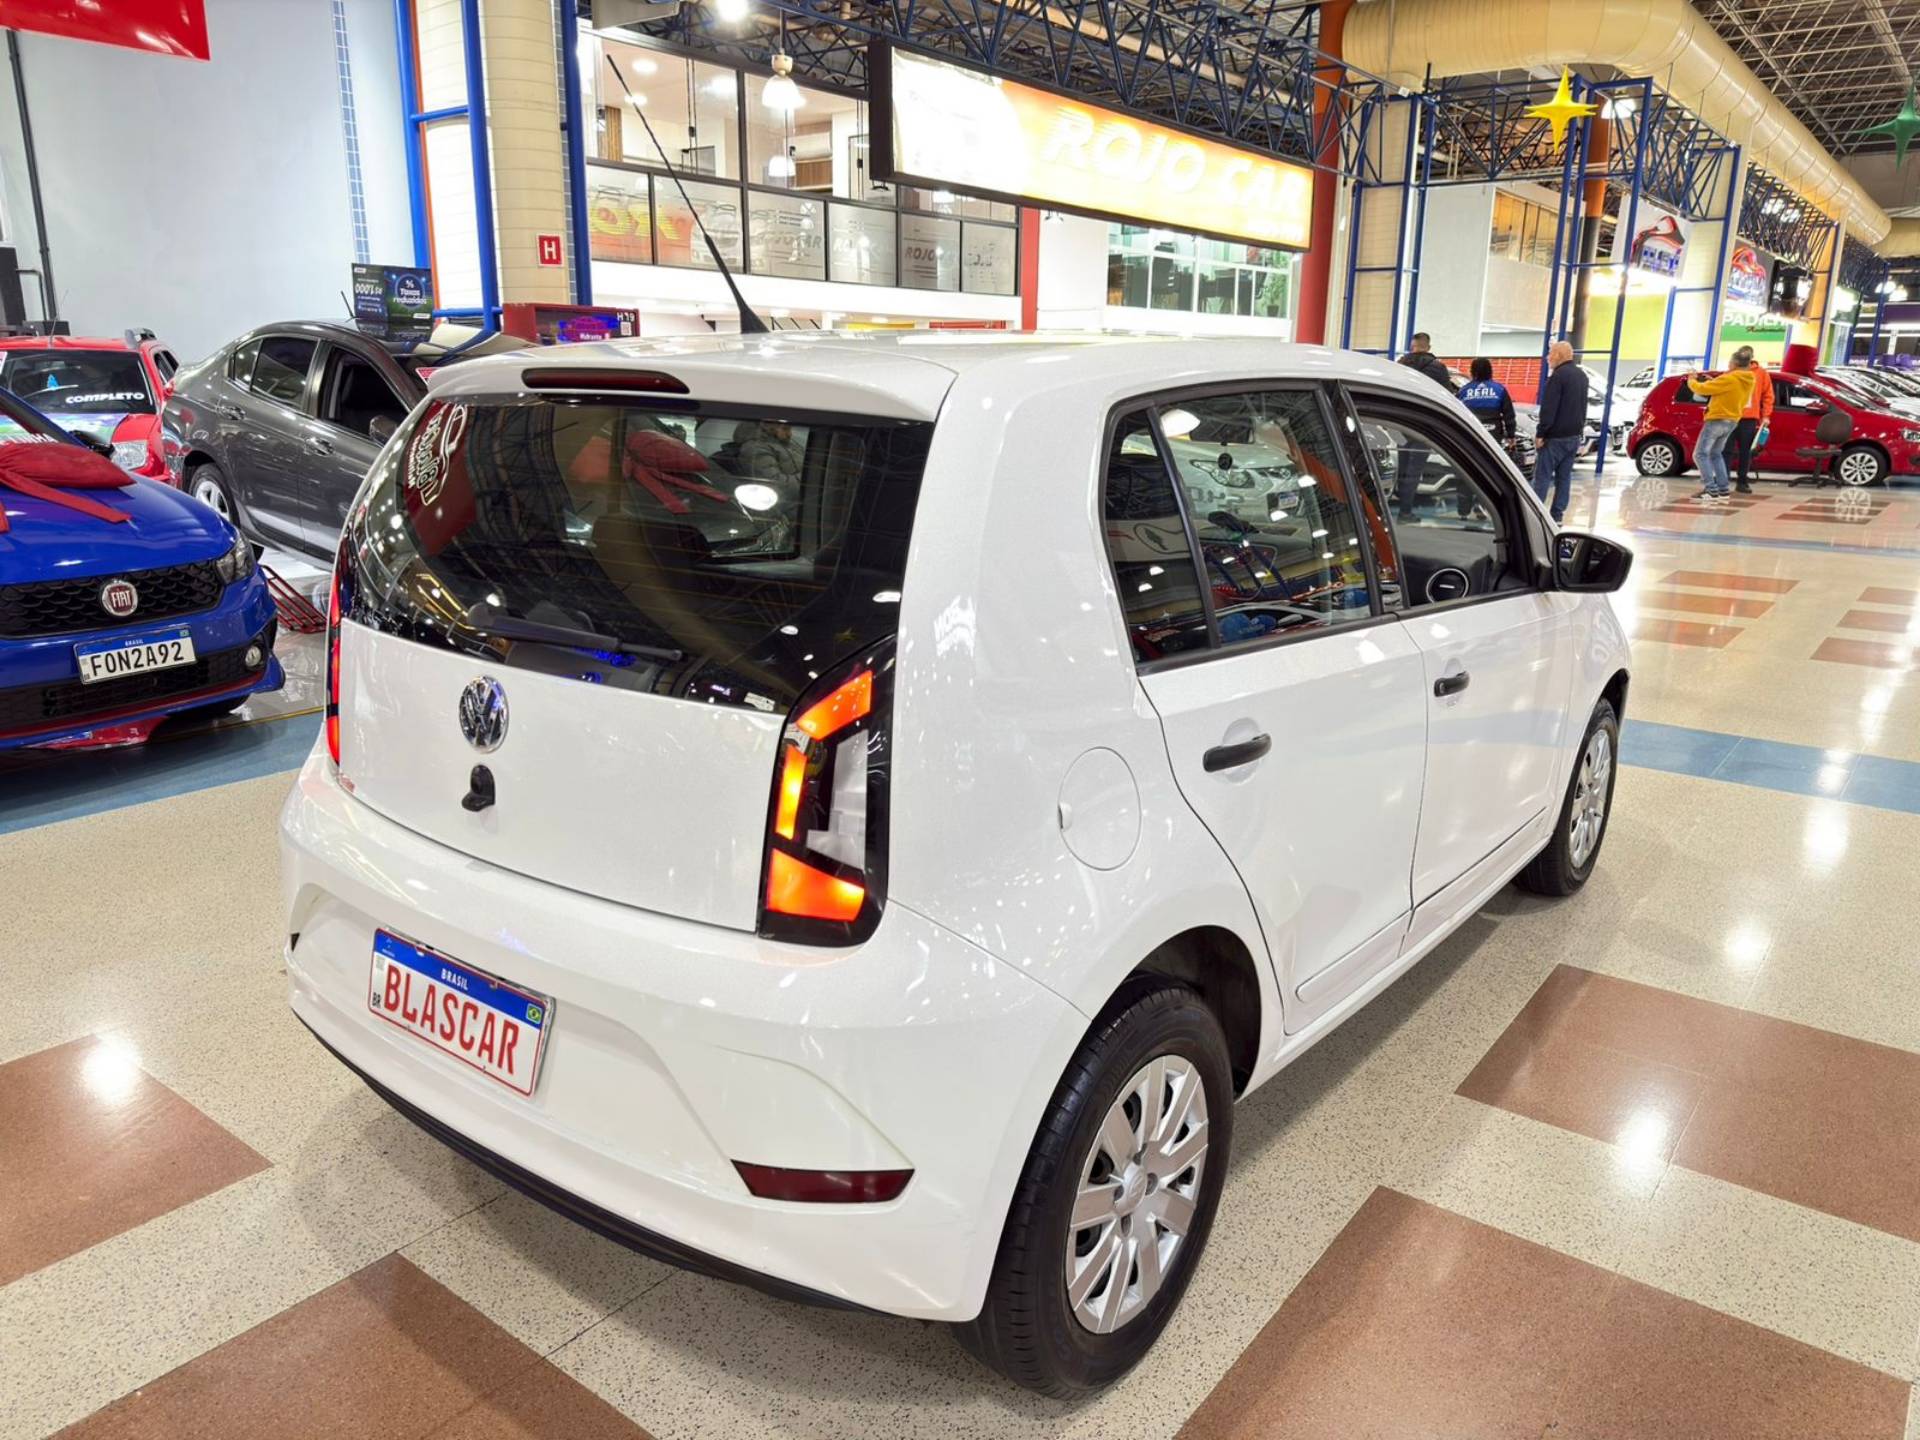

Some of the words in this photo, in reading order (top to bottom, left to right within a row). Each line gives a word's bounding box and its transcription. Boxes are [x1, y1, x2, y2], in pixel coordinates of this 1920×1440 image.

[1042, 105, 1207, 193] ROJO
[1219, 156, 1310, 214] CAR
[544, 240, 557, 260] H
[66, 392, 145, 404] COMPLETO
[1467, 387, 1496, 397] REAL
[110, 590, 132, 608] FIAT
[90, 642, 184, 677] FON2A92
[441, 968, 469, 991] BRASIL
[384, 964, 520, 1075] BLASCAR
